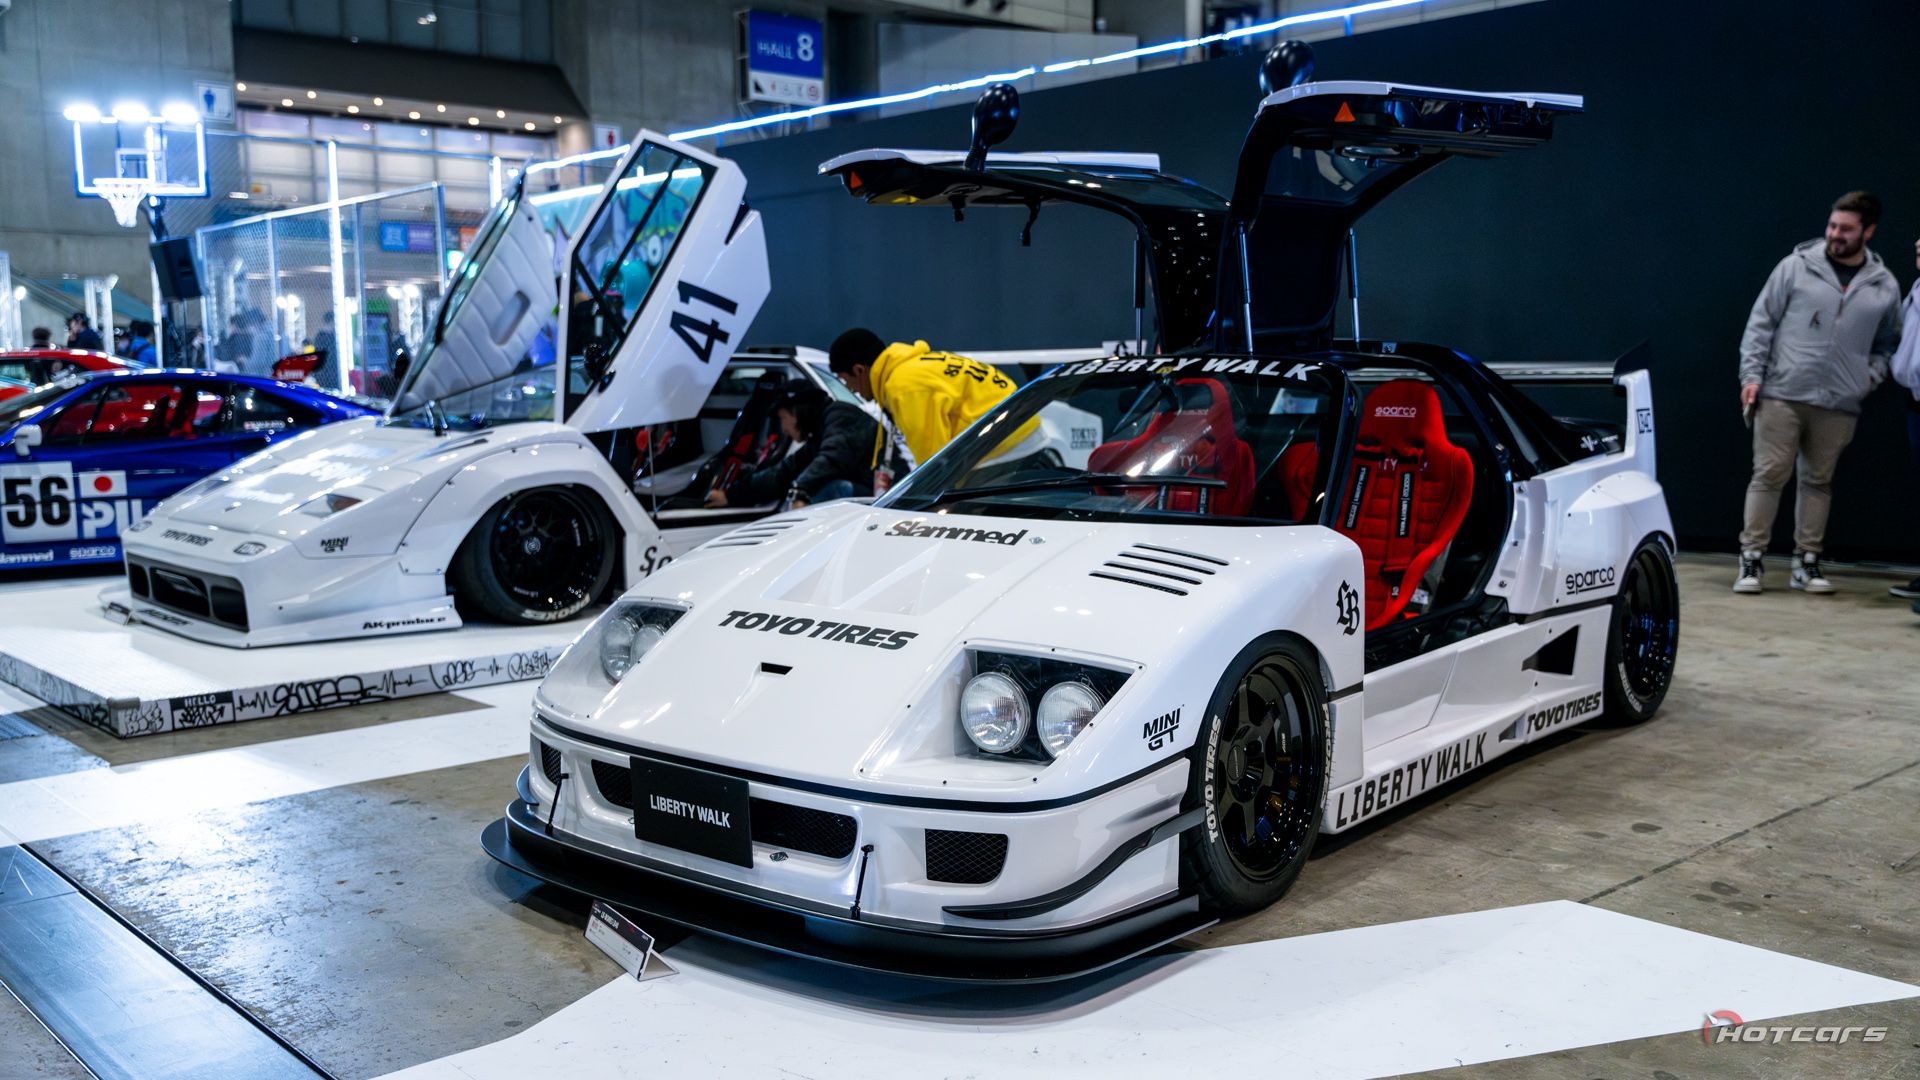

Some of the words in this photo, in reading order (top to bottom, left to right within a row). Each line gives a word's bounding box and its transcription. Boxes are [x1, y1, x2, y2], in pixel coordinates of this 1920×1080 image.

[797, 32, 814, 62] 8
[669, 280, 738, 364] 41
[1044, 358, 1202, 379] LIBERTY
[1202, 358, 1321, 382] WALK
[1375, 406, 1417, 418] sparco
[3, 476, 71, 529] 56
[884, 520, 1029, 546] Slammed
[0, 549, 54, 564] lammed
[1566, 566, 1615, 595] sparco
[718, 610, 815, 635] TOYO
[808, 621, 919, 650] TIRES
[184, 694, 216, 706] HELLO
[1527, 704, 1564, 734] TOYO
[1564, 691, 1602, 720] TIRES
[1143, 708, 1181, 740] MINI
[1148, 724, 1179, 751] GT
[1205, 714, 1222, 782] TIRES
[1336, 755, 1433, 829] LIBERTY
[1436, 732, 1487, 783] WALK
[650, 794, 696, 819] LIBERTY
[696, 805, 731, 828] WALK
[1205, 784, 1219, 843] TOYO
